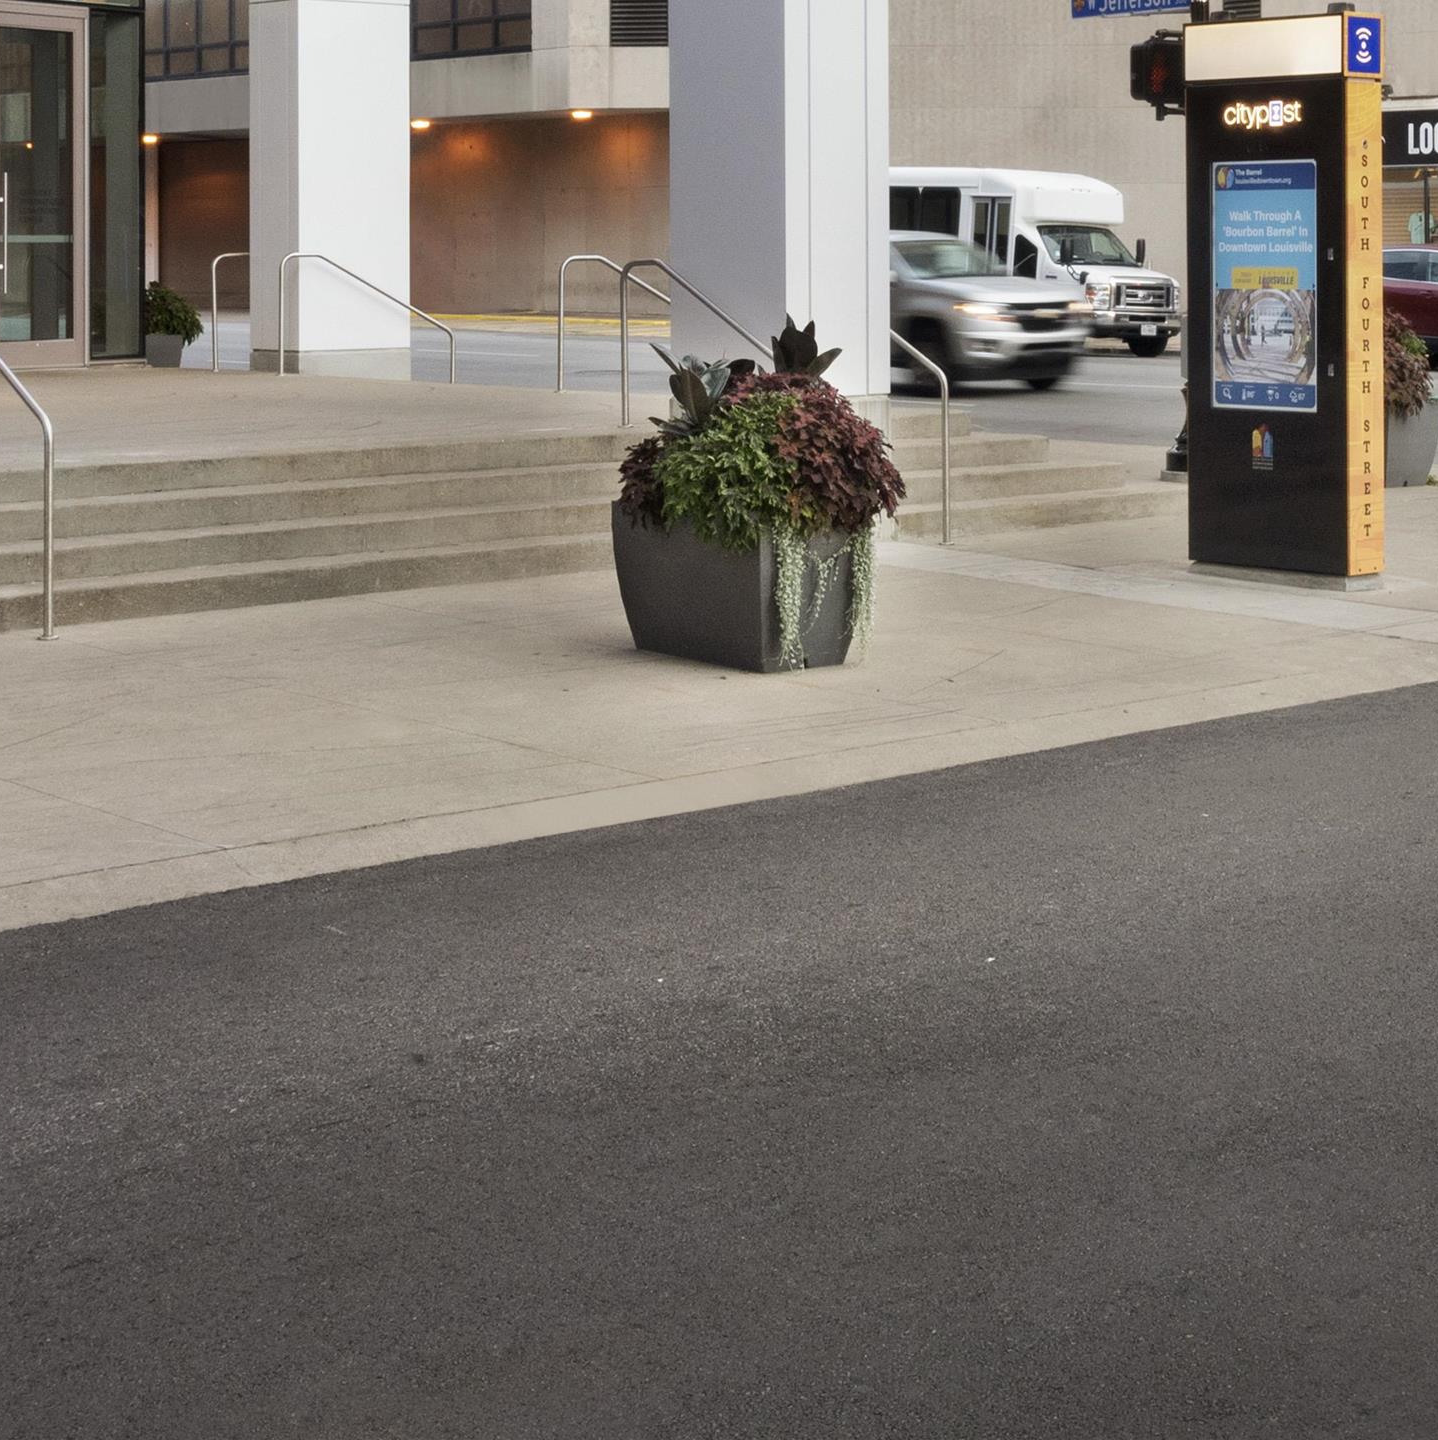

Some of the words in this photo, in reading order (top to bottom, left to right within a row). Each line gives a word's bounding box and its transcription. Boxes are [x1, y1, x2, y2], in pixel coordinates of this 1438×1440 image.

[1229, 211, 1252, 222] Walk
[1254, 210, 1291, 223] Through
[1293, 210, 1302, 221] A
[1360, 155, 1370, 251] SOUTH
[1218, 242, 1267, 253] Downtown
[1269, 241, 1314, 253] Louisville
[1298, 226, 1308, 237] In
[1362, 277, 1371, 394] FOURTH
[1363, 419, 1372, 537] STREET
